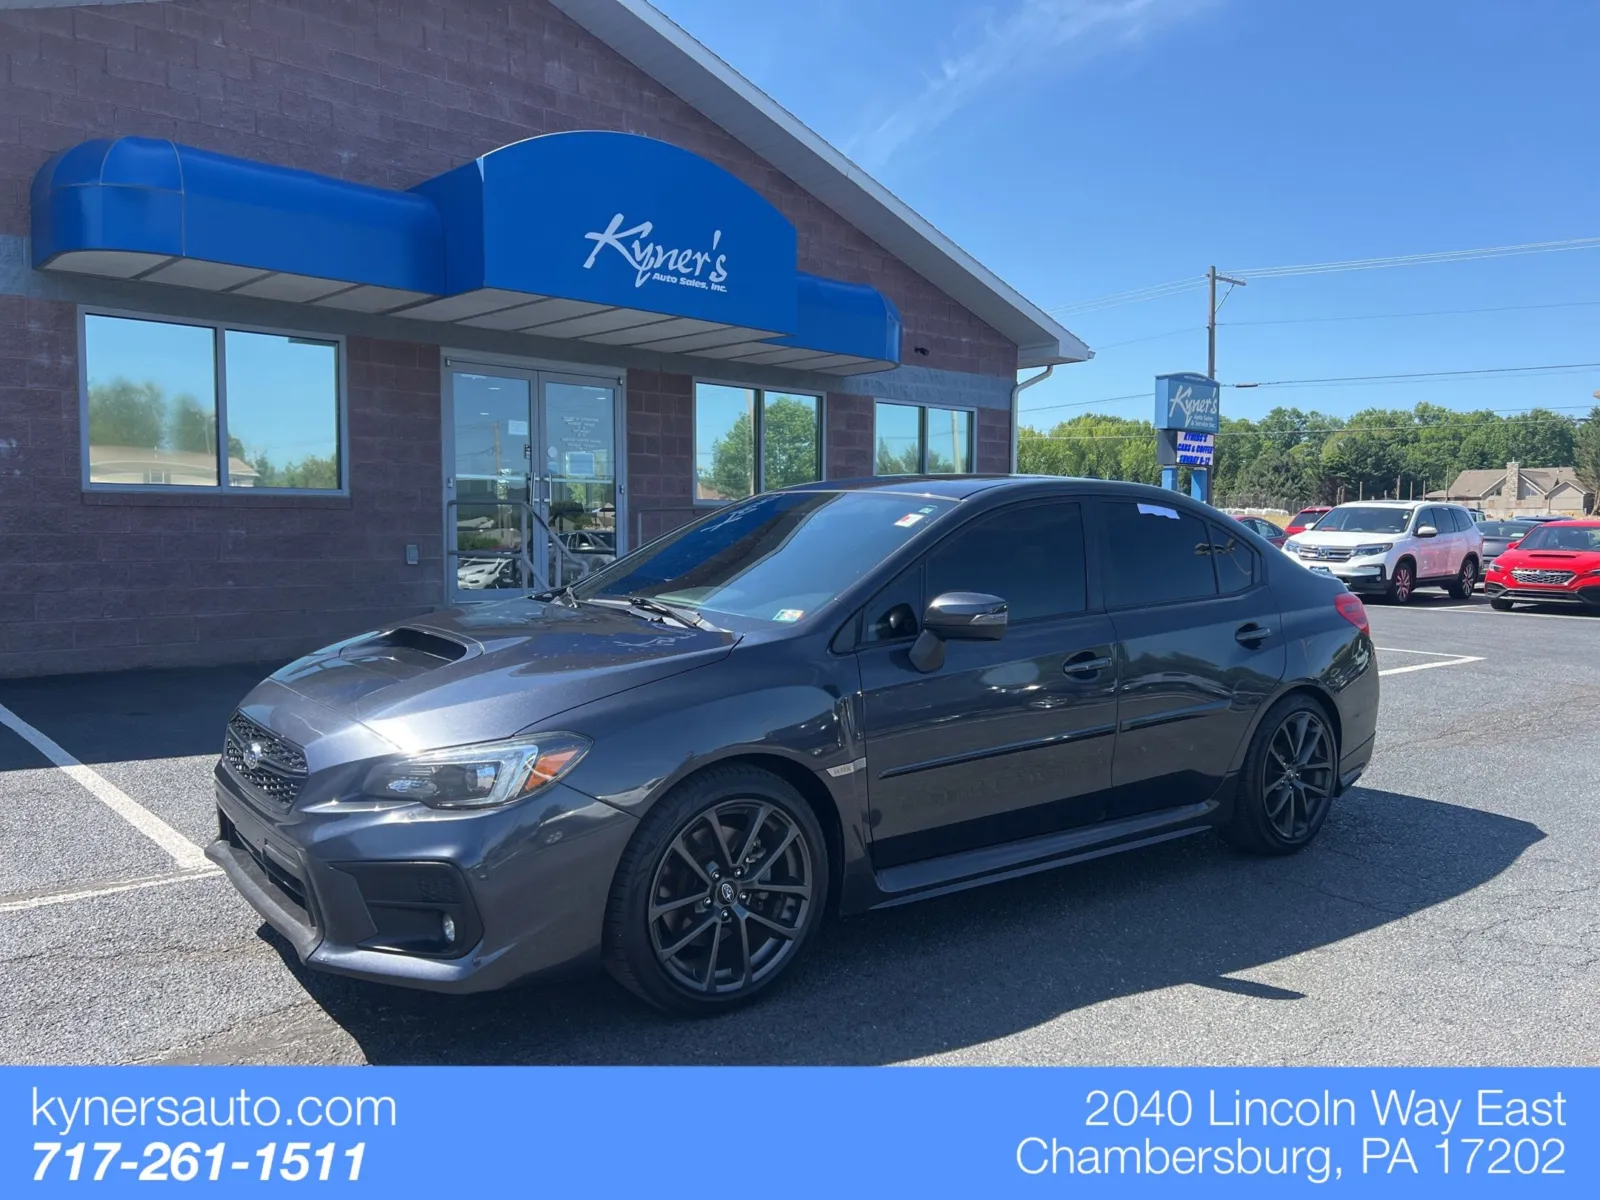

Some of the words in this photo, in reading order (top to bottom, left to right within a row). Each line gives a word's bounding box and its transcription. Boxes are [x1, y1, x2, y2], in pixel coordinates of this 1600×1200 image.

[583, 213, 728, 288] Kyner's
[652, 272, 678, 284] Auto
[679, 276, 709, 290] Sales,
[710, 282, 728, 293] Inc.
[1169, 384, 1217, 428] Kyner's
[1177, 443, 1191, 452] CARS
[1196, 444, 1213, 455] COFFEE
